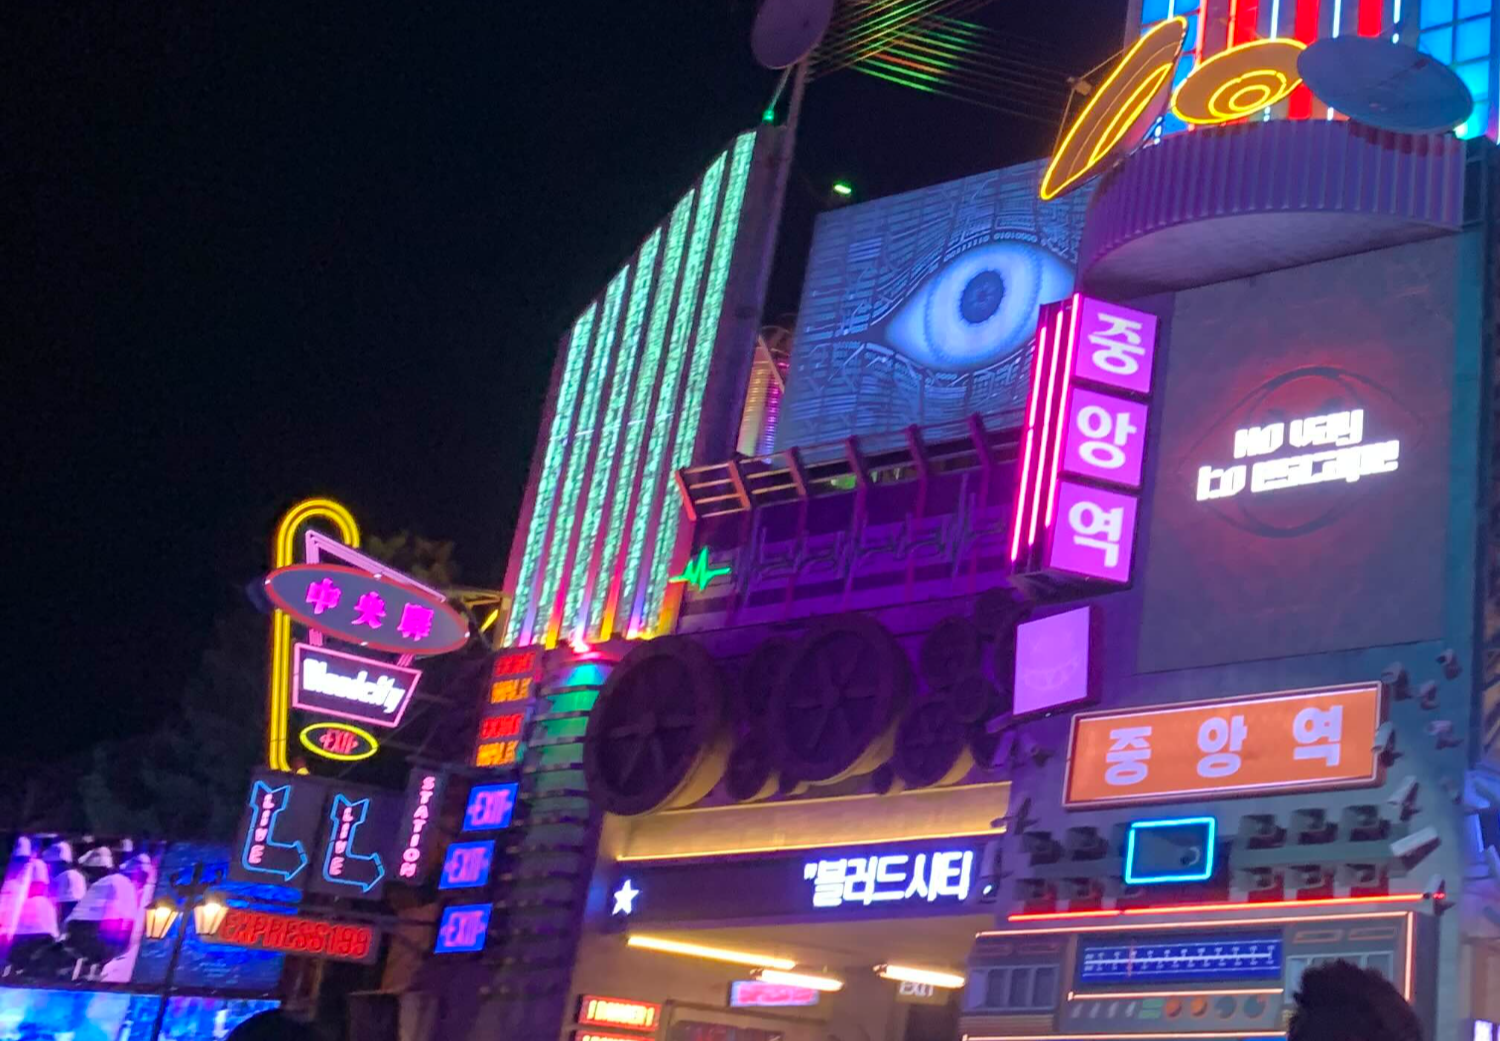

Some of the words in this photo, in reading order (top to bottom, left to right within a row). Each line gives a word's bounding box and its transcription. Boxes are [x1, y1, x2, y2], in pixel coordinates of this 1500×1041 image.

[1068, 312, 1146, 568] 중앙역
[1104, 705, 1344, 786] 중앙역
[248, 793, 275, 864] LIVE
[328, 806, 354, 876] LIVE
[399, 776, 436, 878] STATION
